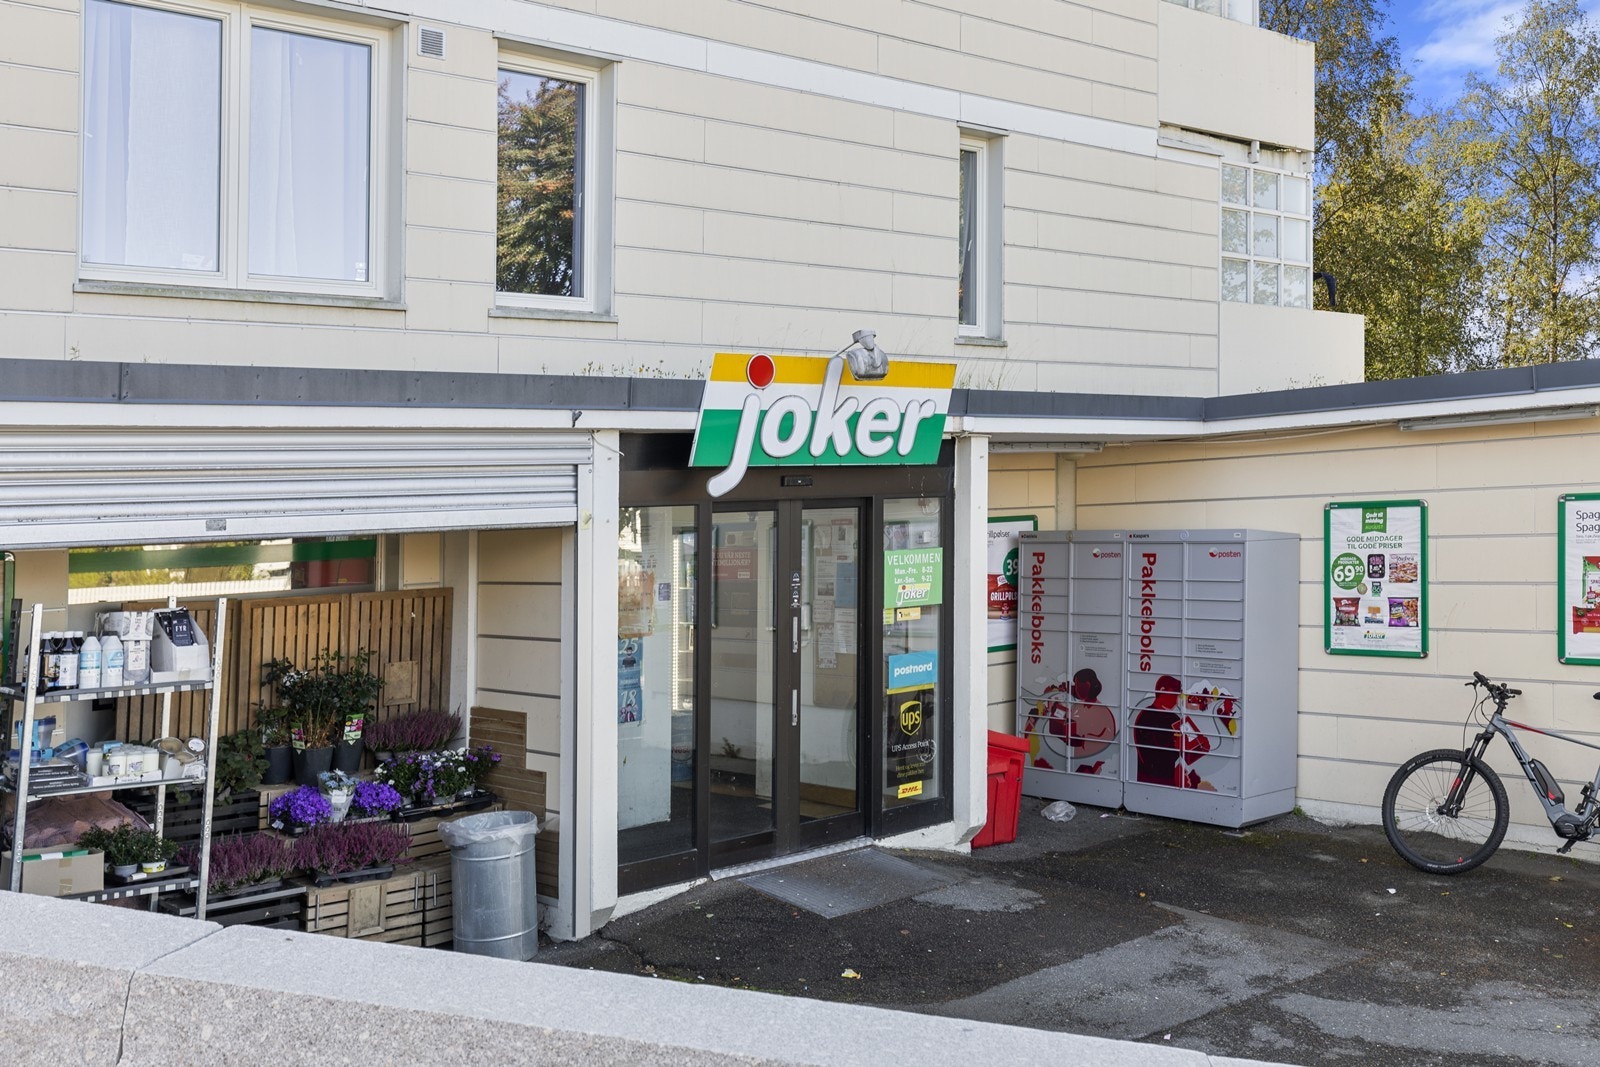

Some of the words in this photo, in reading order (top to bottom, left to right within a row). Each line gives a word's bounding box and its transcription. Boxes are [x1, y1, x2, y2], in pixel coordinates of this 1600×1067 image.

[706, 353, 936, 497] joker
[1346, 536, 1365, 544] GODE
[1366, 535, 1403, 543] MIDDAGER
[1378, 542, 1403, 550] PRISER
[887, 553, 941, 566] VELKOMMEN
[1100, 551, 1121, 560] posten
[1218, 550, 1242, 560] posten
[1333, 564, 1355, 583] 69
[1355, 565, 1364, 573] 90
[896, 584, 928, 606] joker
[1031, 552, 1045, 665] Pakkeboks
[1140, 552, 1157, 672] Pakkeboks
[894, 662, 933, 678] postnord
[620, 689, 637, 708] 18
[902, 711, 920, 731] ups
[891, 744, 902, 753] UPS
[902, 742, 917, 751] Access
[917, 740, 929, 748] Point
[901, 786, 919, 794] DHL
